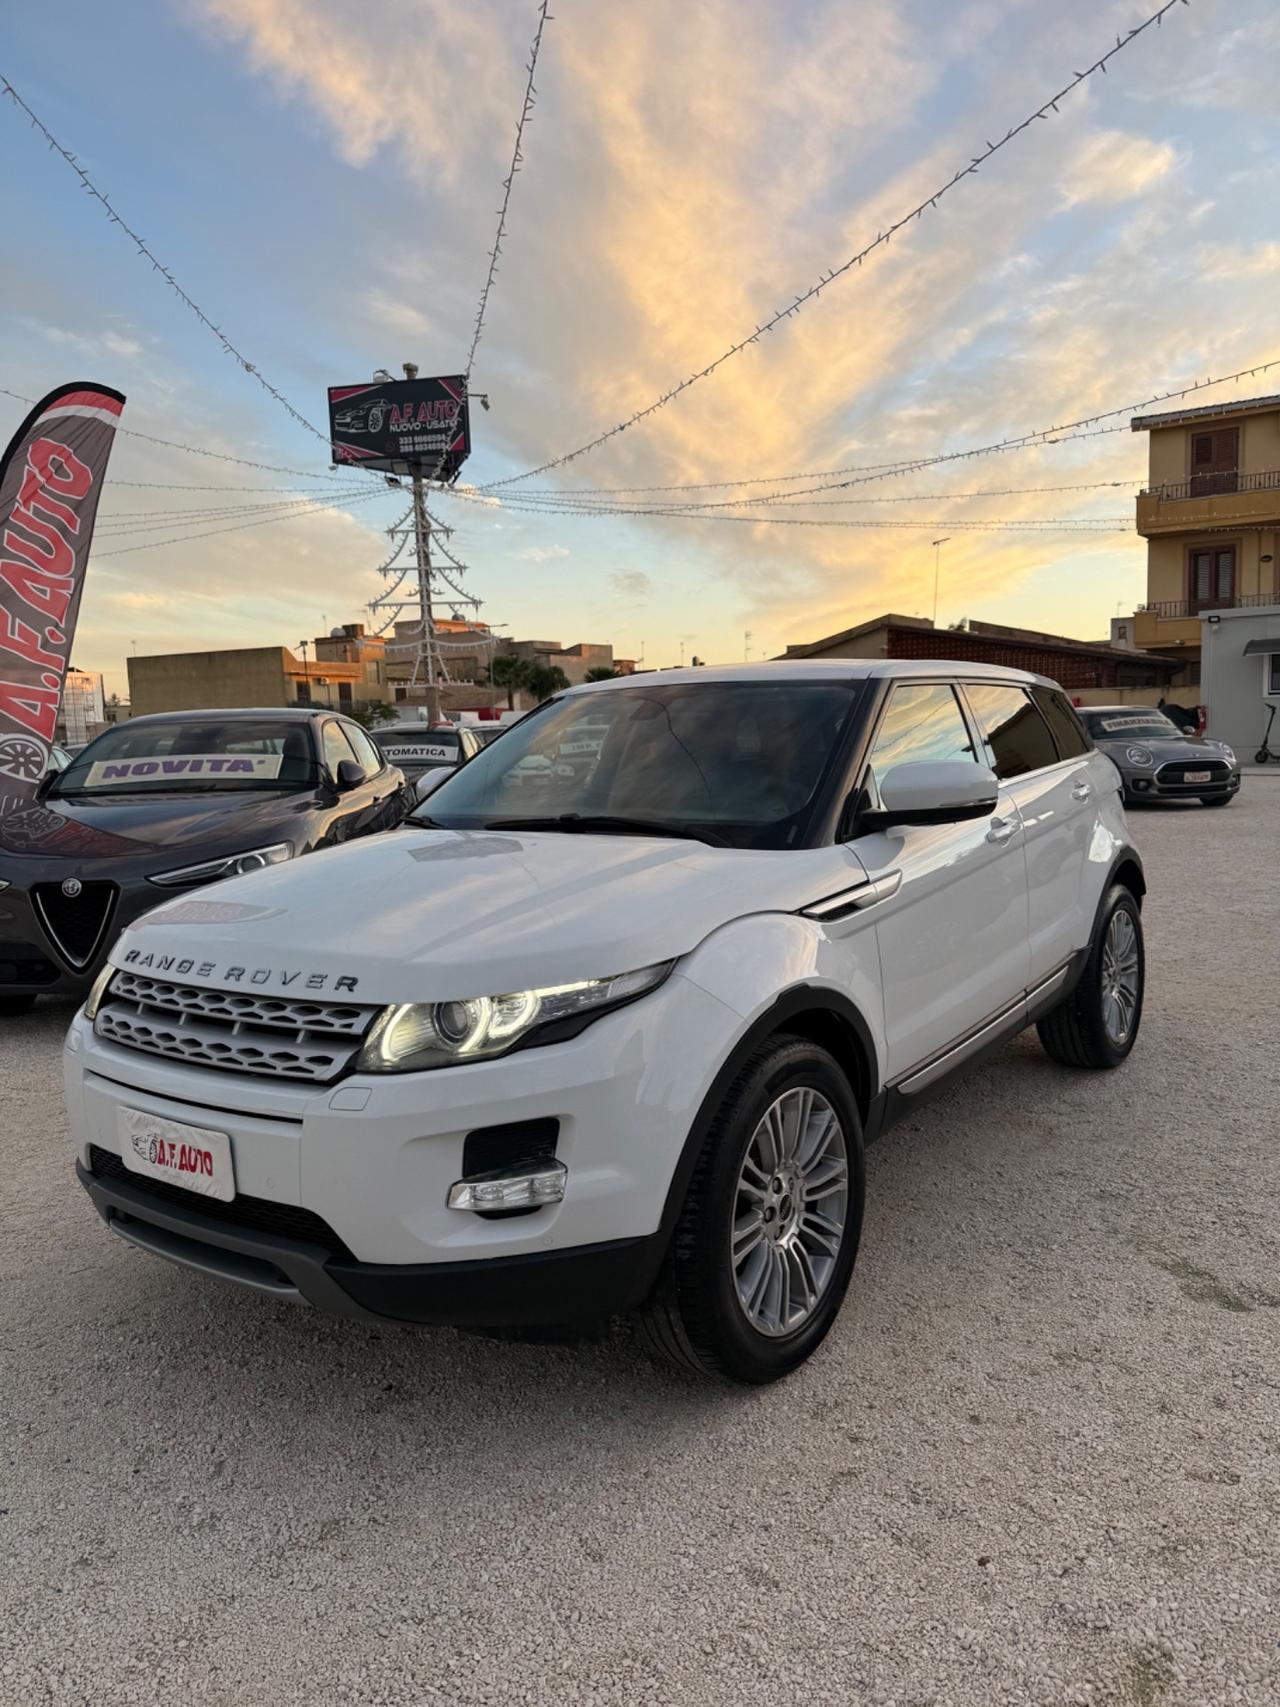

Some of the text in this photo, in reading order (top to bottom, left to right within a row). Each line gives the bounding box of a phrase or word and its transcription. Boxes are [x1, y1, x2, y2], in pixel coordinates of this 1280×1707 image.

[417, 400, 458, 421] AUTO
[389, 421, 421, 432] NUOVO
[384, 747, 446, 757] TOMATICA
[125, 949, 359, 993] RANGE ROVER
